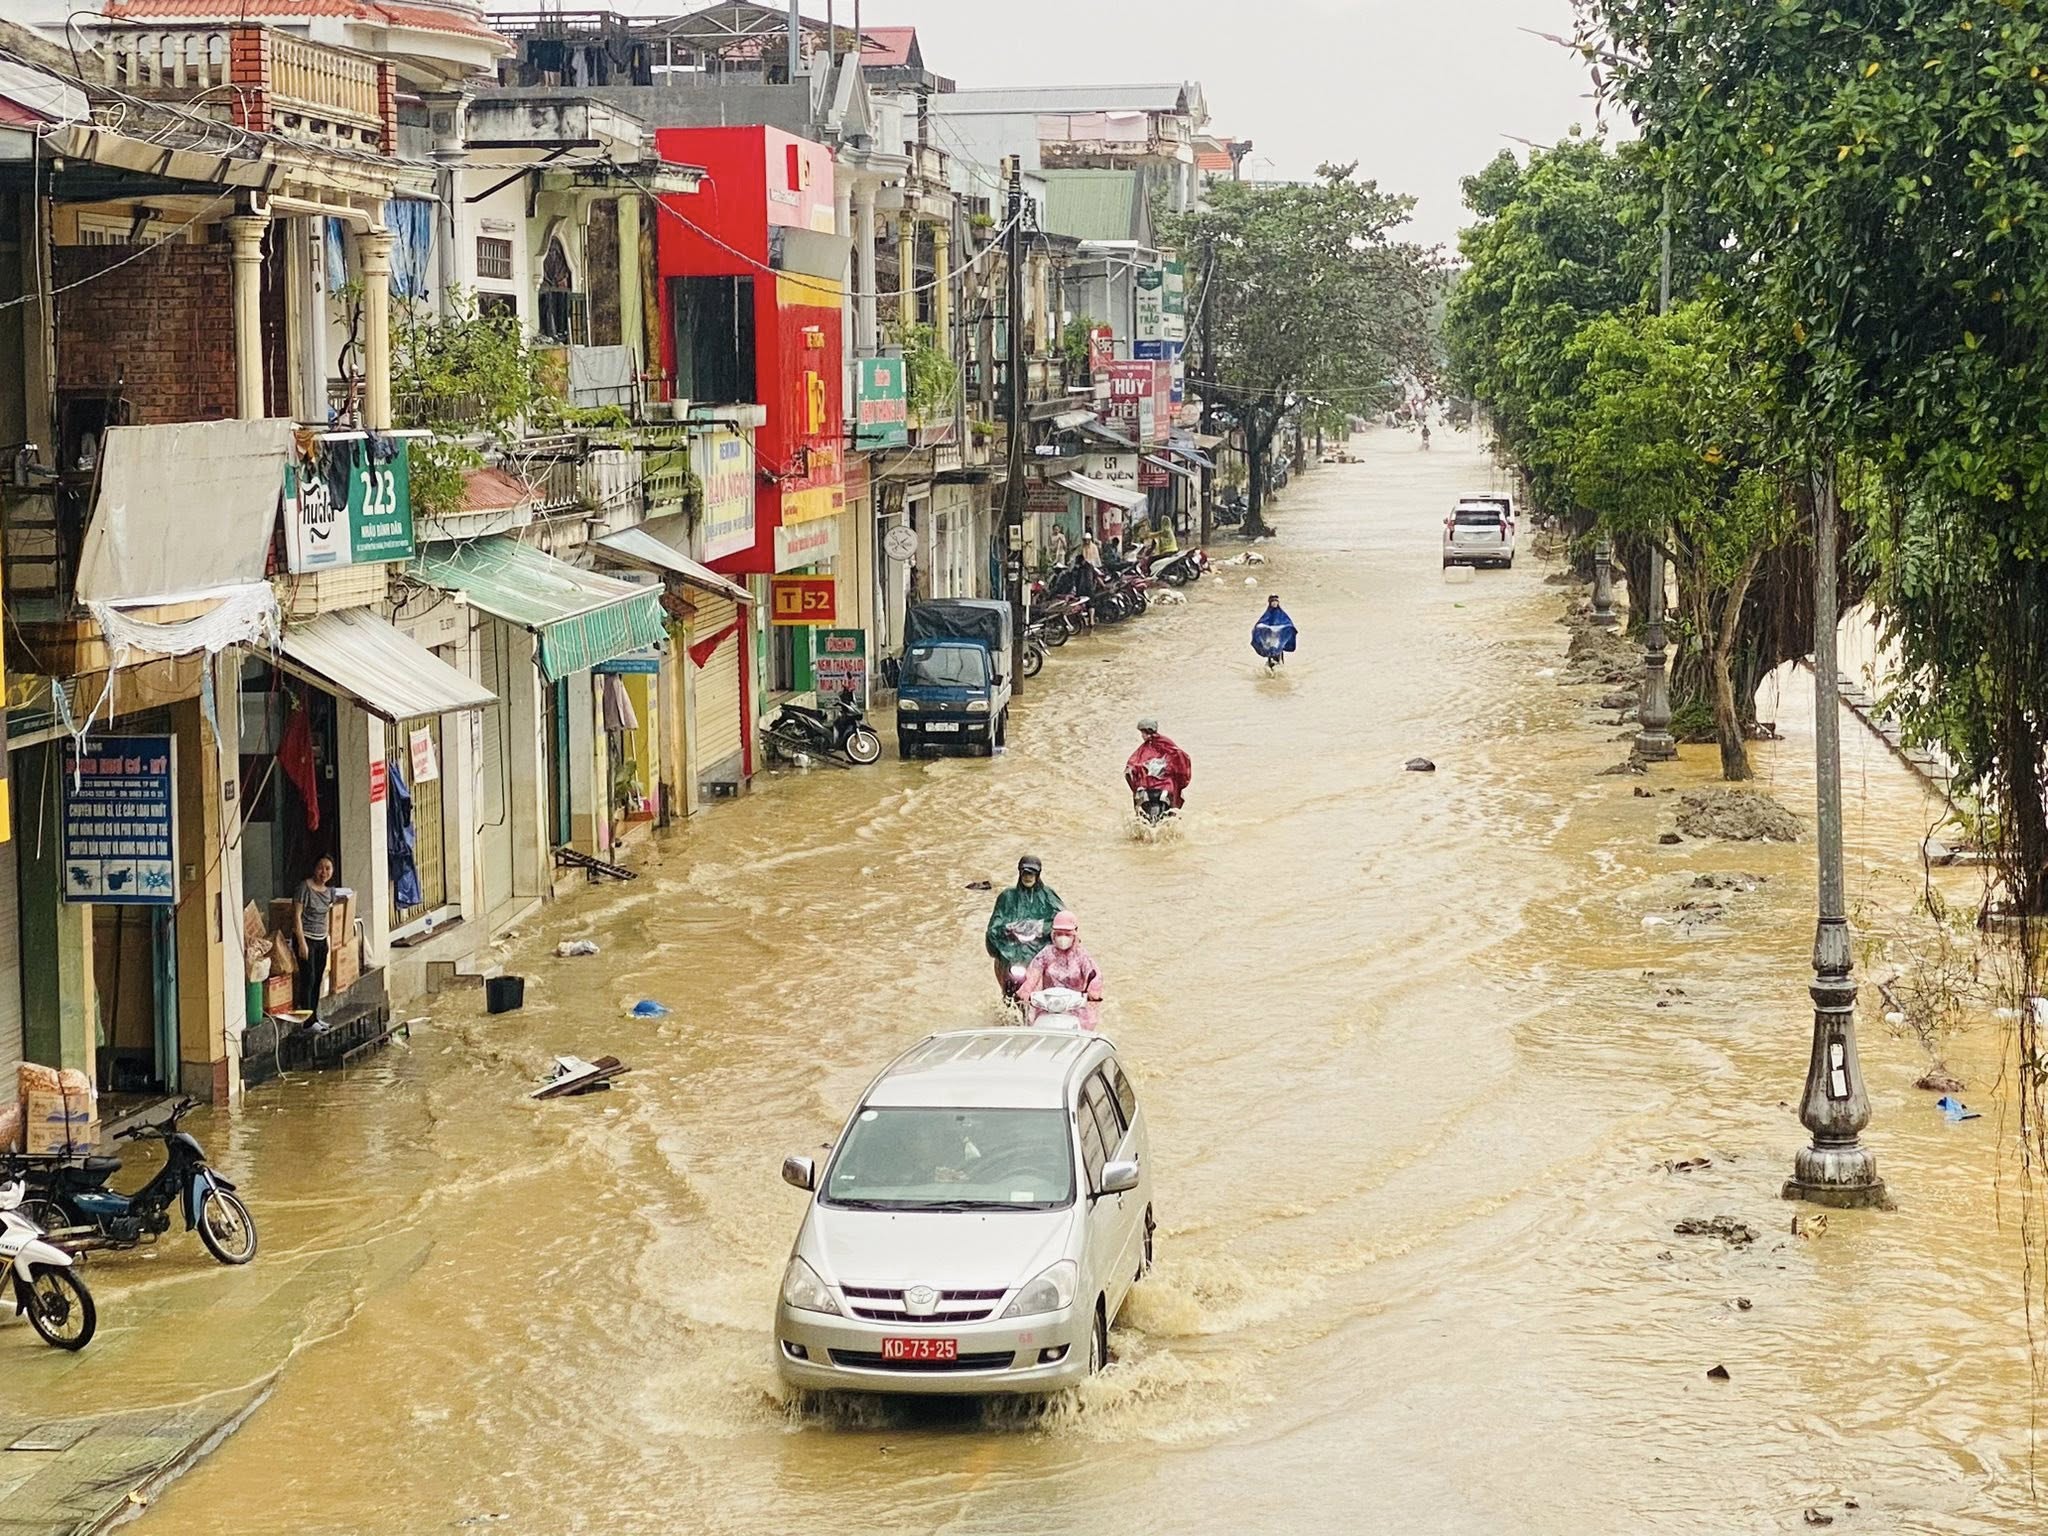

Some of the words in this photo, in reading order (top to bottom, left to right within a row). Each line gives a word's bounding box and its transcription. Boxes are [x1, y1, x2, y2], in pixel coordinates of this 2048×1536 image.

[361, 470, 396, 516] 223
[804, 592, 830, 609] 52
[884, 1339, 954, 1358] KD-73-25
